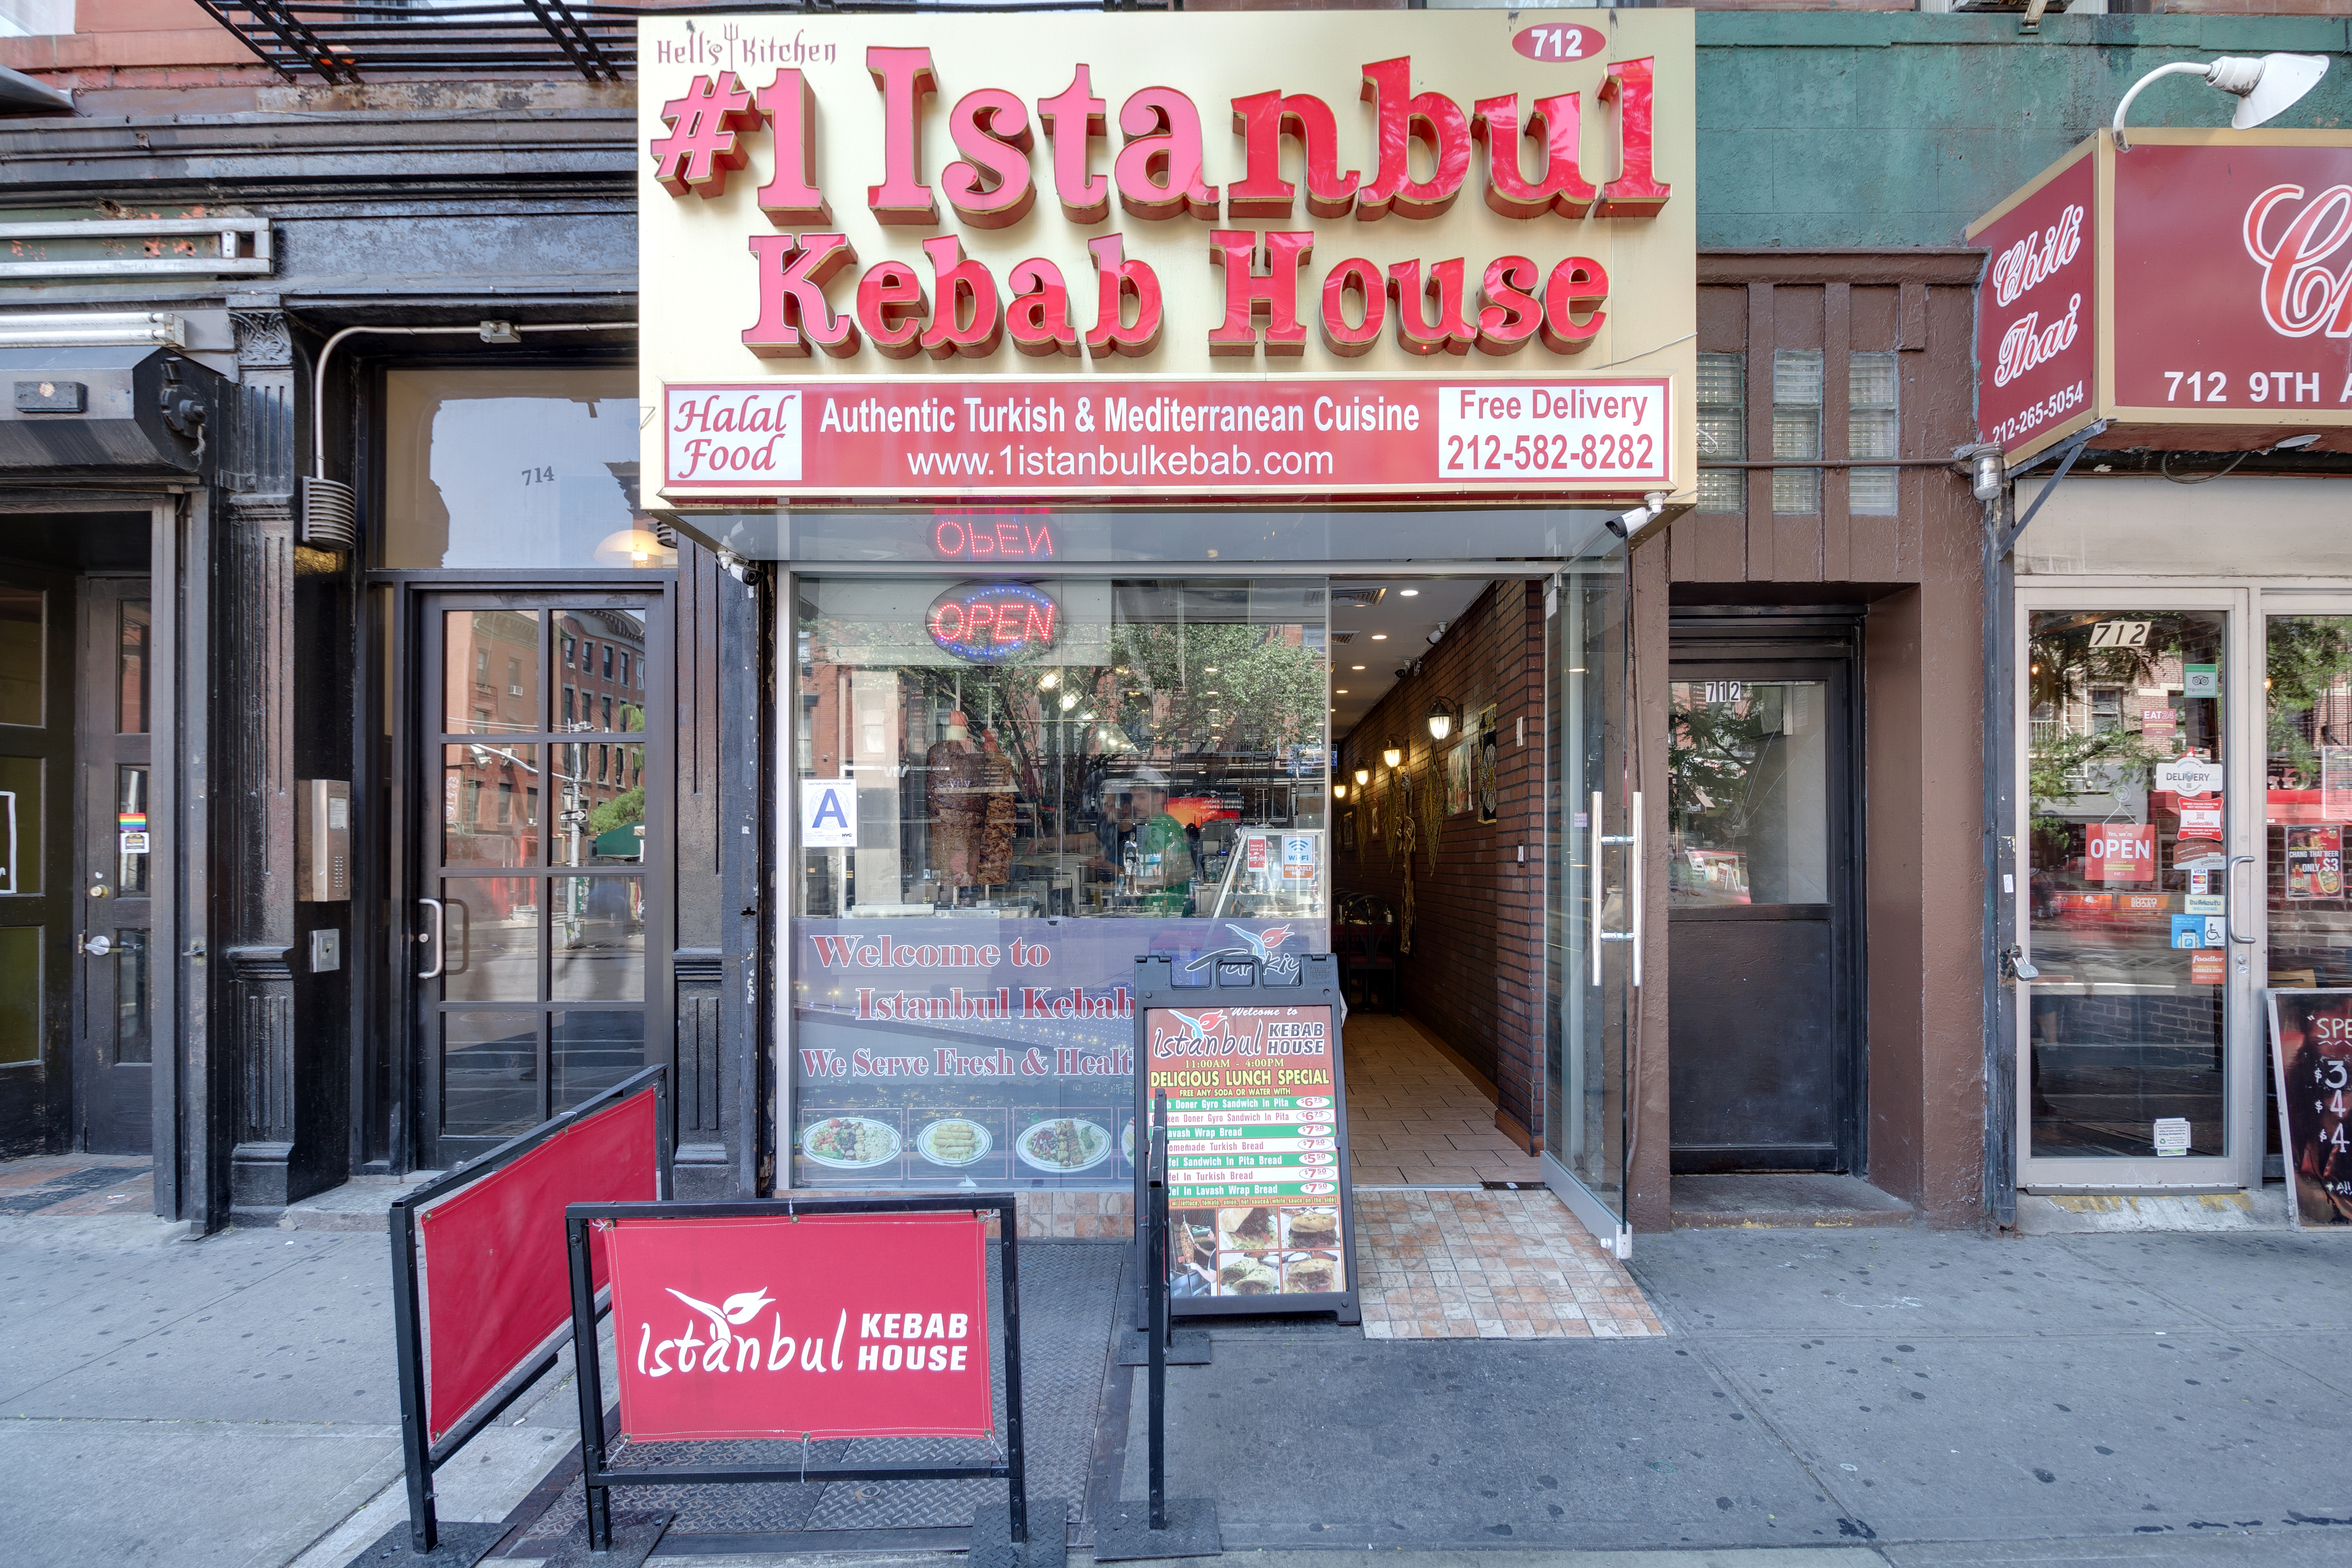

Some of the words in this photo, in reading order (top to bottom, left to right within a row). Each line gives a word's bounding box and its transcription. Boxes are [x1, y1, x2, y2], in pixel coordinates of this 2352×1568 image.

[657, 29, 722, 66] Hell's
[742, 29, 836, 66] Kitchen
[1532, 29, 1582, 57] 712
[651, 68, 832, 226] #1
[866, 46, 1672, 229] Istanbul
[1993, 204, 2084, 307] Chili
[741, 233, 1163, 360] Kebab
[1208, 229, 1611, 357] House
[1995, 293, 2081, 388] Thai
[2164, 371, 2227, 402] 712
[2249, 372, 2320, 402] 9TH
[673, 394, 797, 433] Halal
[820, 398, 955, 434] Authentic
[964, 397, 1064, 433] Turkish
[1076, 397, 1095, 433] &
[1105, 397, 1303, 433] Mediterranean
[1314, 395, 1419, 432] Cuisine
[1461, 390, 1521, 419] Free
[1532, 389, 1648, 425] Delivery
[1992, 380, 2084, 444] 212-265-5054
[677, 434, 786, 478] Food
[908, 444, 1333, 475] www.1istanbulkebab.com
[1448, 434, 1653, 469] 212-582-8282
[522, 466, 554, 485] 714
[936, 604, 1053, 640] OPEN
[2094, 624, 2146, 645] 712
[1707, 682, 1740, 701] 712
[2144, 711, 2174, 719] EAT24
[812, 789, 848, 828] A
[2090, 838, 2150, 859] OPEN
[2302, 864, 2321, 872] ONLY
[2323, 857, 2339, 872] $3
[810, 934, 1000, 968] Welcome
[1008, 936, 1051, 967] to
[2192, 955, 2224, 963] foodler
[855, 988, 1012, 1020] Istanbul
[1019, 987, 1135, 1020] Kebab
[1230, 1007, 1280, 1017] Welcome
[1287, 1007, 1298, 1016] to
[1153, 1018, 1263, 1059] Istanbul
[1267, 1022, 1325, 1038] KEBAB
[1266, 1039, 1325, 1055] HOUSE
[799, 1048, 847, 1077] We
[853, 1048, 929, 1077] Serve
[933, 1048, 1015, 1076] Fresh
[1020, 1047, 1049, 1076] &
[1185, 1059, 1231, 1068] 11:00AM
[1245, 1058, 1284, 1067] 4:00PM
[2314, 1060, 2348, 1089] $3
[1150, 1070, 1220, 1087] DELICIOUS
[1226, 1069, 1271, 1086] LUNCH
[1278, 1069, 1329, 1085] SPECIAL
[1214, 1088, 1233, 1096] SODA
[1248, 1088, 1272, 1096] WATER
[1176, 1100, 1198, 1109] Doner
[1202, 1099, 1218, 1110] Gyro
[1222, 1098, 1258, 1108] Sandwich
[1262, 1098, 1270, 1107] In
[1274, 1097, 1289, 1107] Pita
[2314, 1089, 2347, 1118] $4
[1184, 1114, 1204, 1122] Doner
[1208, 1113, 1223, 1124] Gyro
[1227, 1113, 1261, 1121] Sandwich
[1265, 1112, 1271, 1121] In
[1276, 1112, 1289, 1121] Pita
[1167, 1128, 1190, 1138] avash
[1195, 1128, 1215, 1139] Wrap
[1220, 1127, 1242, 1137] Bread
[1169, 1143, 1205, 1151] omemade
[1210, 1142, 1237, 1151] Turkish
[1242, 1142, 1263, 1150] Bread
[2319, 1122, 2351, 1153] $4
[1183, 1157, 1222, 1167] Sandwich
[1226, 1157, 1234, 1166] In
[1239, 1156, 1254, 1166] Pita
[1259, 1156, 1282, 1165] Bread
[1184, 1172, 1191, 1181] In
[1196, 1172, 1225, 1180] Turkish
[1230, 1171, 1253, 1180] Bread
[1184, 1187, 1191, 1196] In
[1196, 1186, 1224, 1196] Lavash
[1229, 1185, 1250, 1197] Wrap
[1254, 1185, 1278, 1194] Bread
[1324, 1196, 1337, 1204] side)
[860, 1313, 968, 1339] KEBAB
[637, 1308, 847, 1378] Istanbul
[857, 1345, 967, 1371] HOUSE
